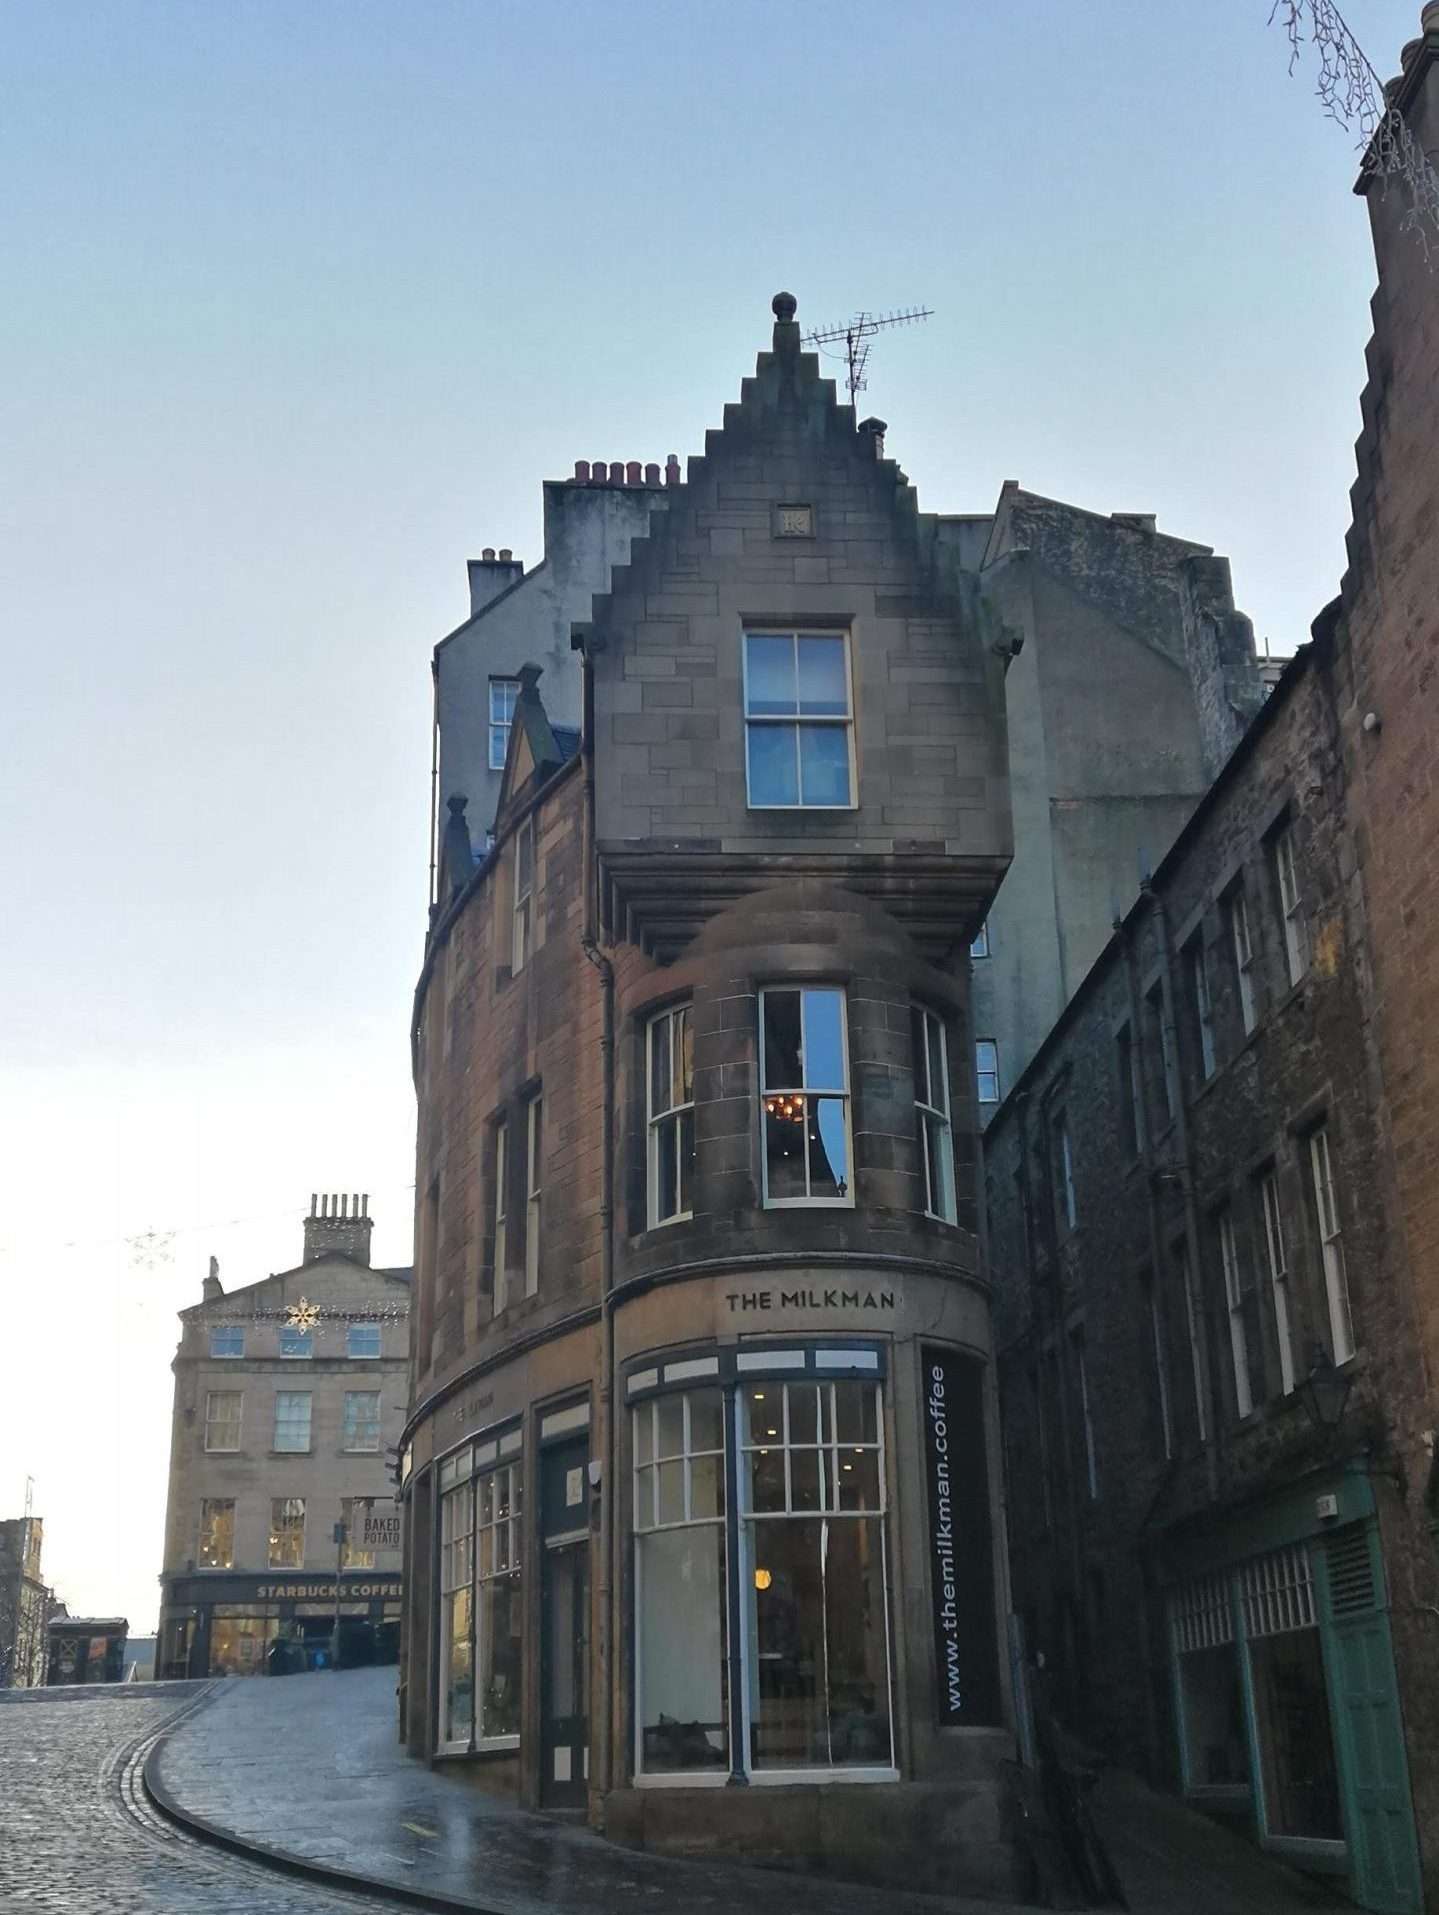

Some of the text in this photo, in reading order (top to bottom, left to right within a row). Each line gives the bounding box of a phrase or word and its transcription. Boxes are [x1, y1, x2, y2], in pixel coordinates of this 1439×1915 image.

[725, 1289, 895, 1312] THE MILKMAN
[364, 1518, 400, 1532] BAKED
[363, 1532, 400, 1545] POTATO
[929, 1365, 961, 1712] www.themilkman.coffee
[257, 1585, 347, 1598] STARBUCKS
